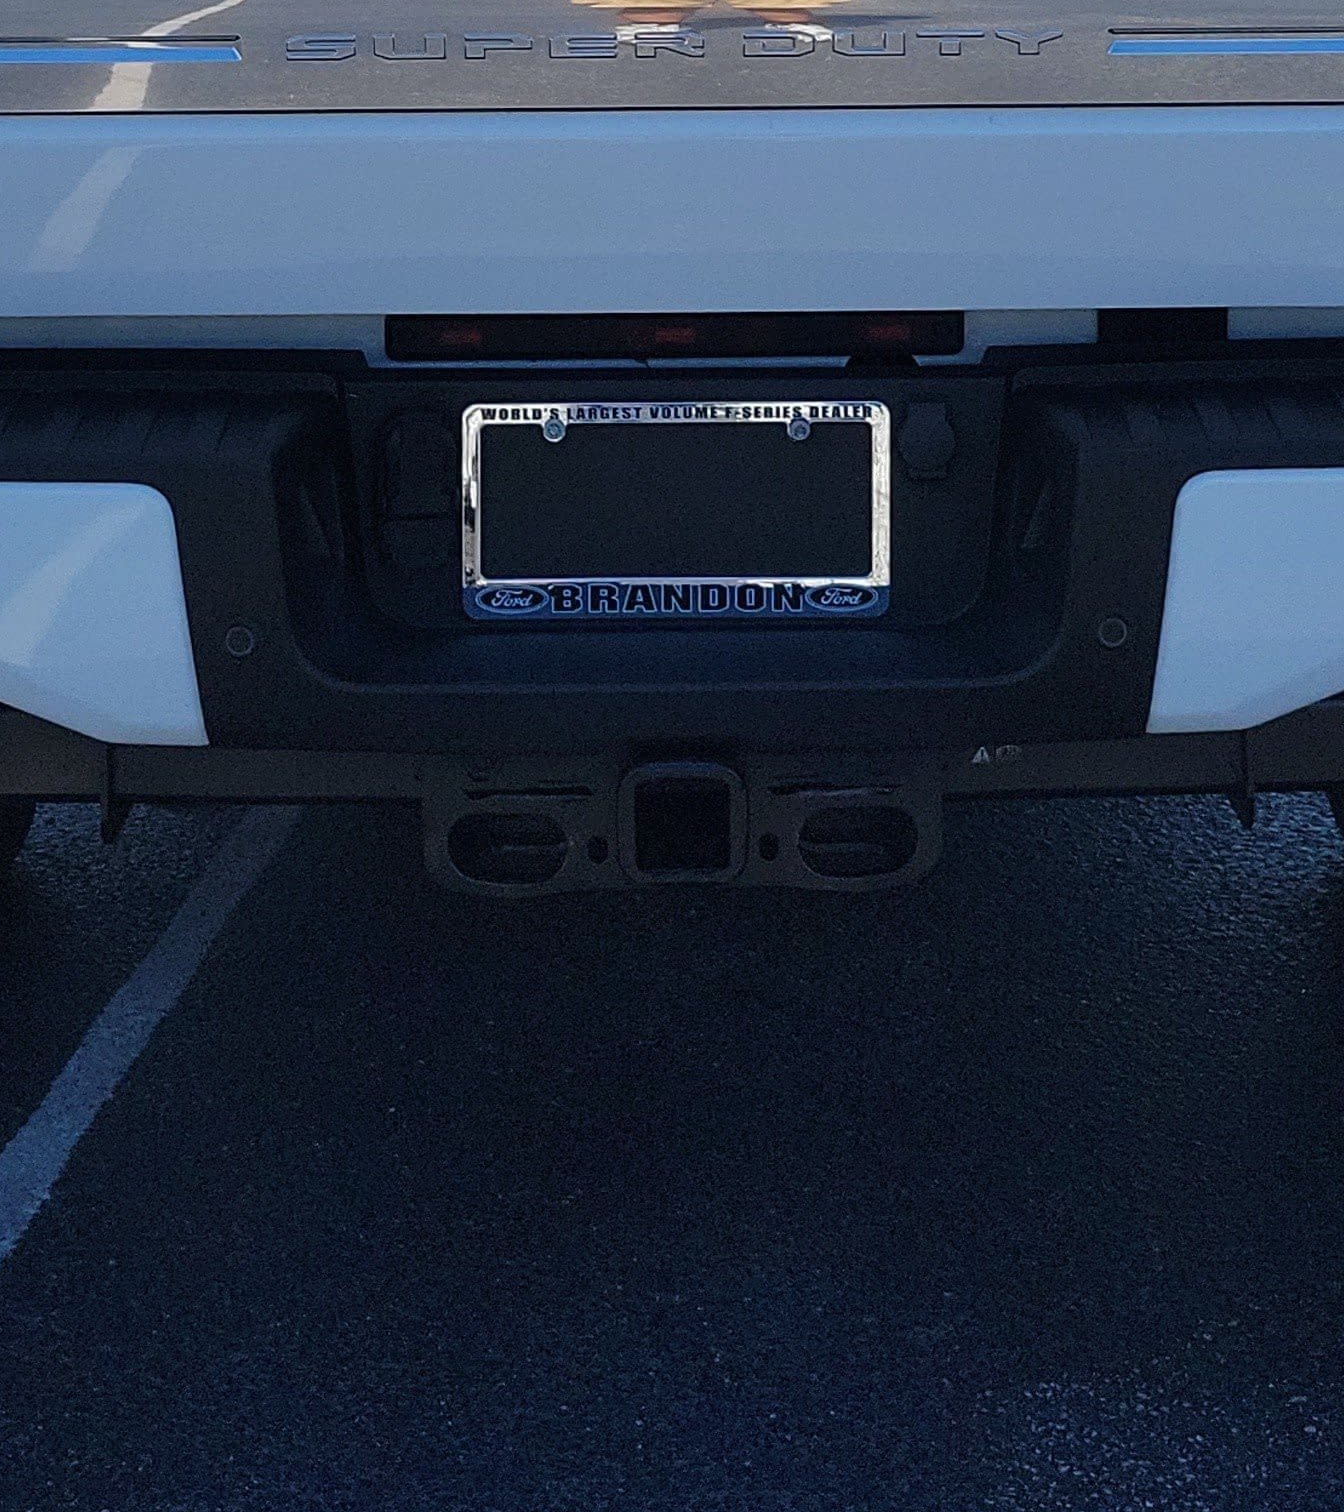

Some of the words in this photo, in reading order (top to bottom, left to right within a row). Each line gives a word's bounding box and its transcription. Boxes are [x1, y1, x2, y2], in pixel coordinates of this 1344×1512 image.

[285, 29, 705, 61] SUPER
[742, 29, 1064, 58] DUTY
[481, 407, 560, 421] WORLD'S
[567, 406, 643, 420] LARGEST
[649, 405, 719, 419] VOLUME
[725, 405, 803, 418] F-SERIES
[809, 404, 873, 418] DEALER
[490, 589, 534, 607] Ford
[548, 582, 806, 613] BRANDON
[821, 588, 862, 605] Ford
